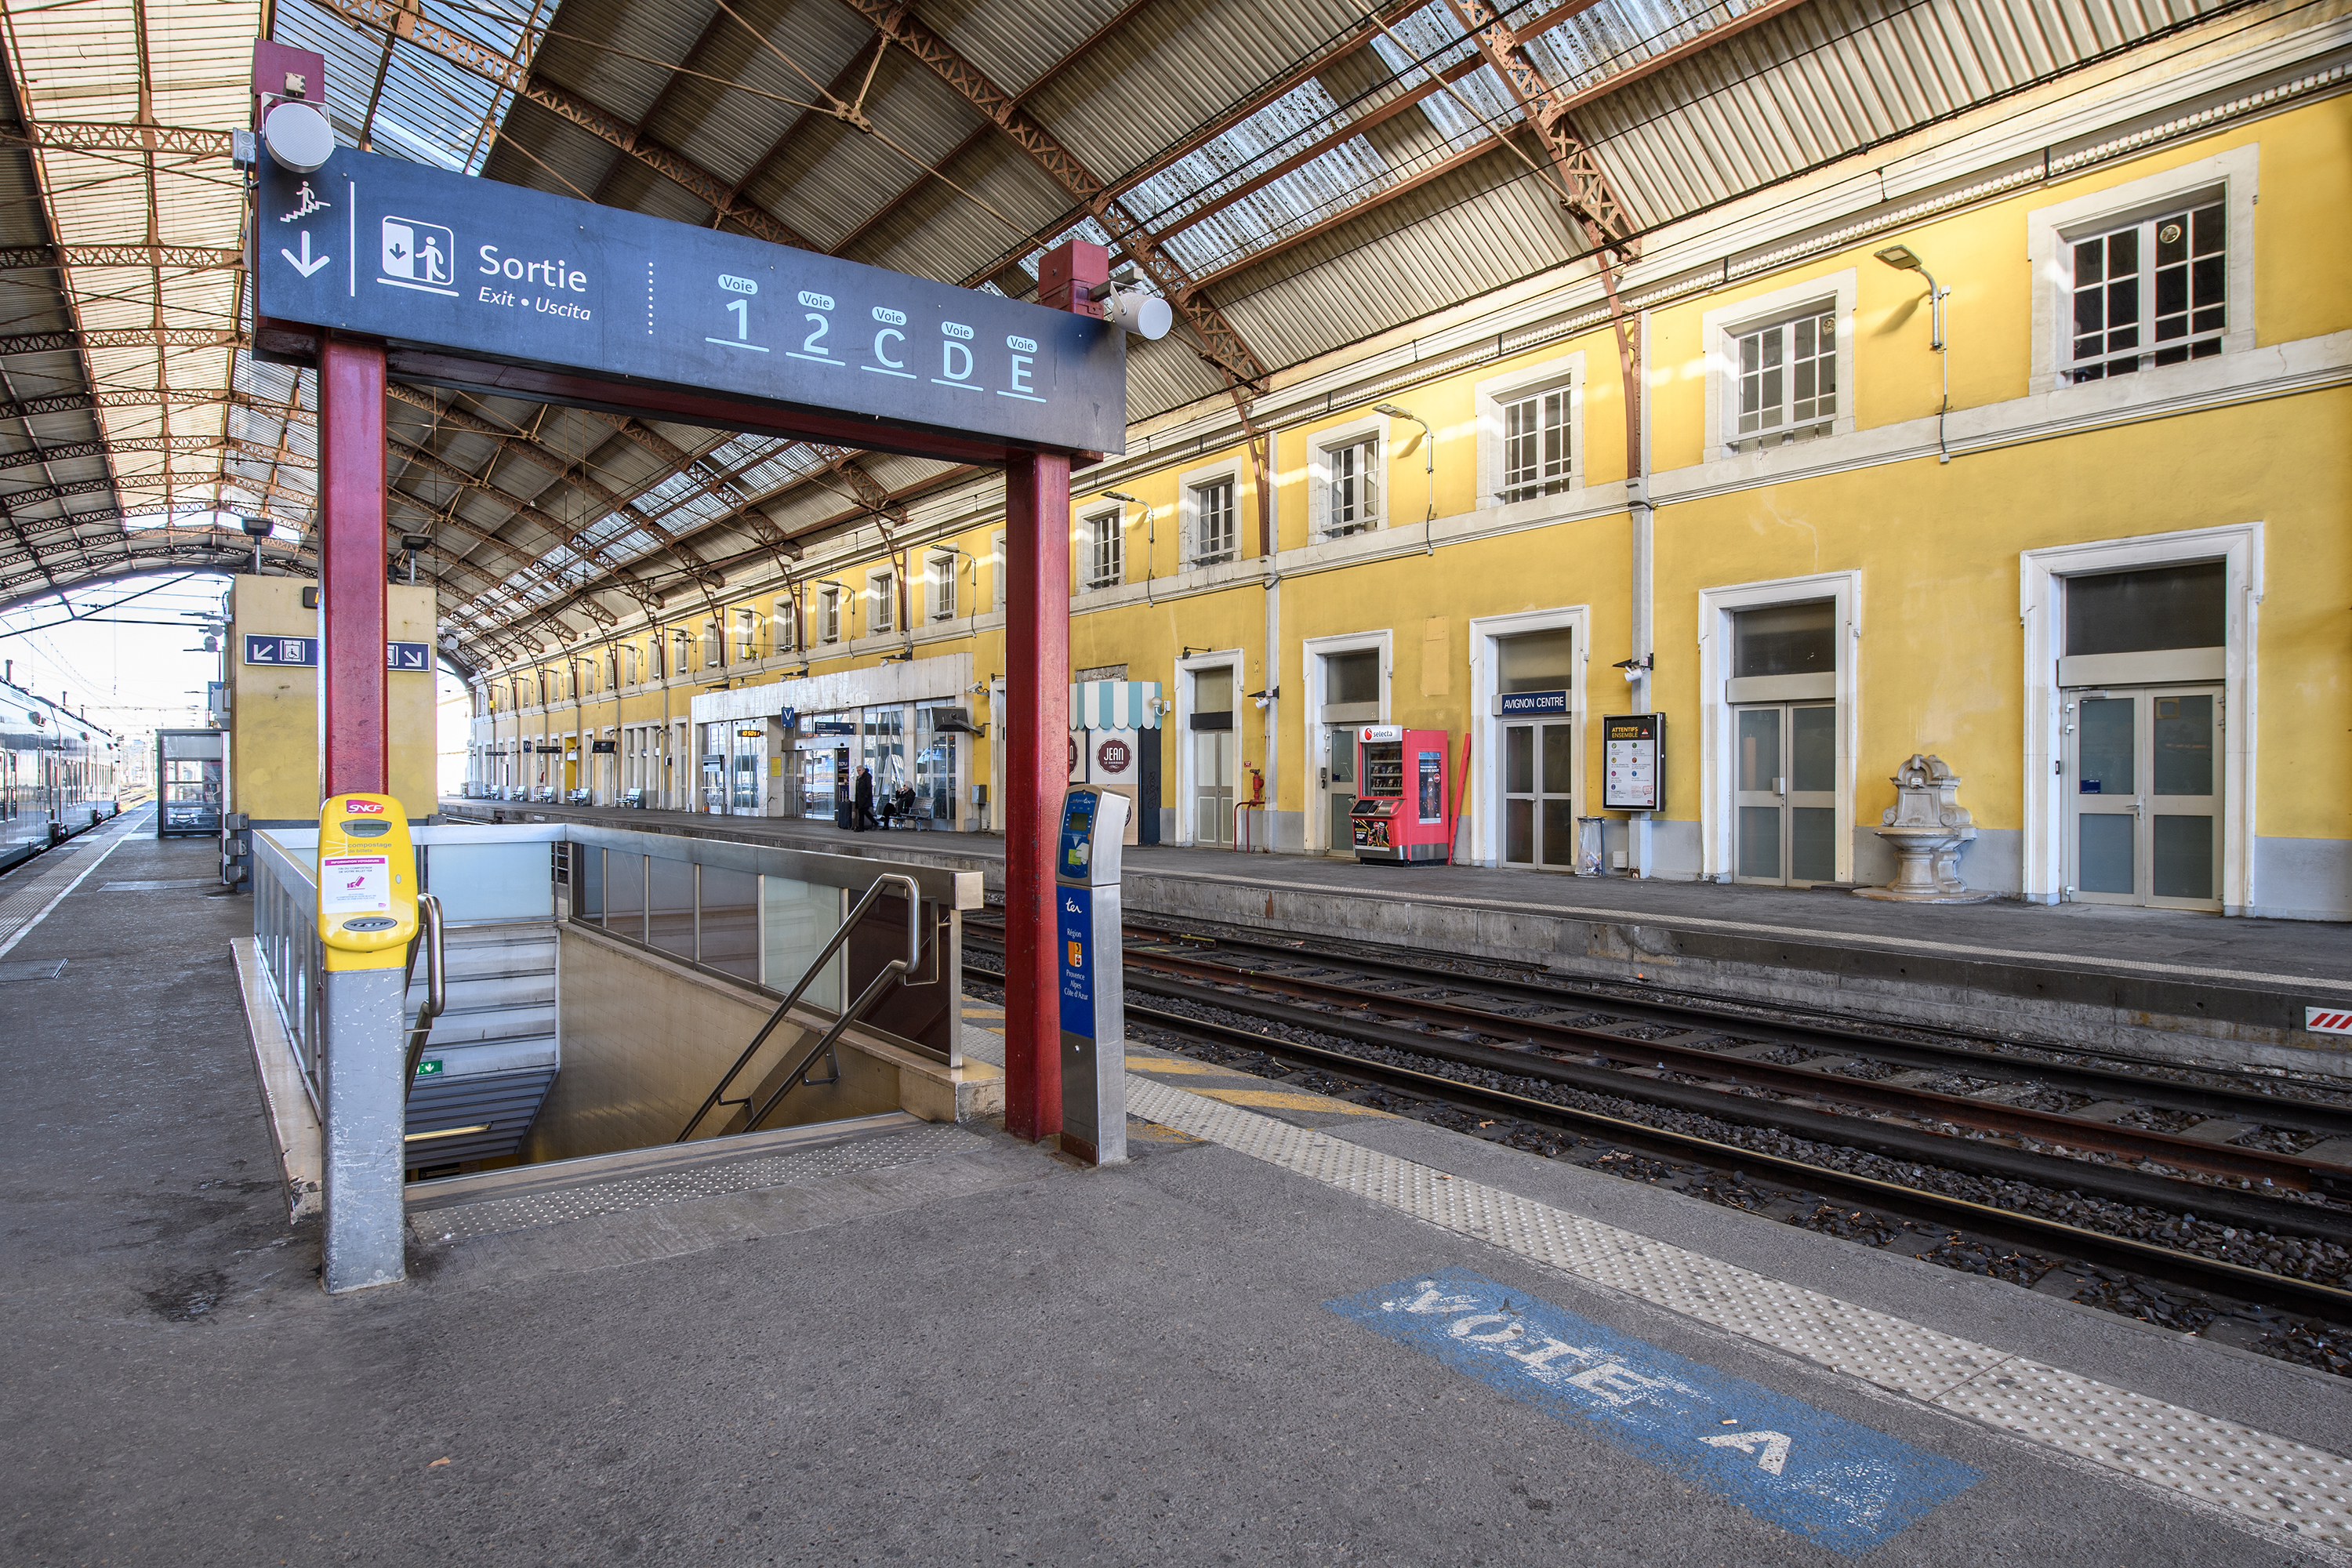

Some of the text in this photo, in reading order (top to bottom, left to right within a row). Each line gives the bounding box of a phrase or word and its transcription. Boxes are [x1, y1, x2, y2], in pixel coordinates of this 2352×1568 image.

[479, 245, 587, 292] Sortie
[723, 276, 753, 292] Voie
[478, 286, 591, 321] Exit Uscita
[802, 292, 830, 308] Voie
[726, 299, 747, 340] 1
[876, 308, 902, 323] Voie
[804, 313, 829, 355] 2
[946, 323, 970, 337] Voie
[874, 328, 906, 368] C
[1010, 337, 1033, 351] Voie
[943, 340, 973, 380] D
[1011, 354, 1033, 394] E
[1504, 696, 1564, 709] AVIGNON CENTRE
[784, 710, 792, 720] V
[1103, 747, 1124, 760] JEAN
[1065, 897, 1083, 913] ter
[1067, 928, 1082, 939] Région
[1066, 969, 1086, 980] Provence
[1069, 980, 1082, 989] Alpes
[1064, 988, 1089, 1000] Côte d'Azur
[1381, 1280, 1793, 1476] VOIE A
